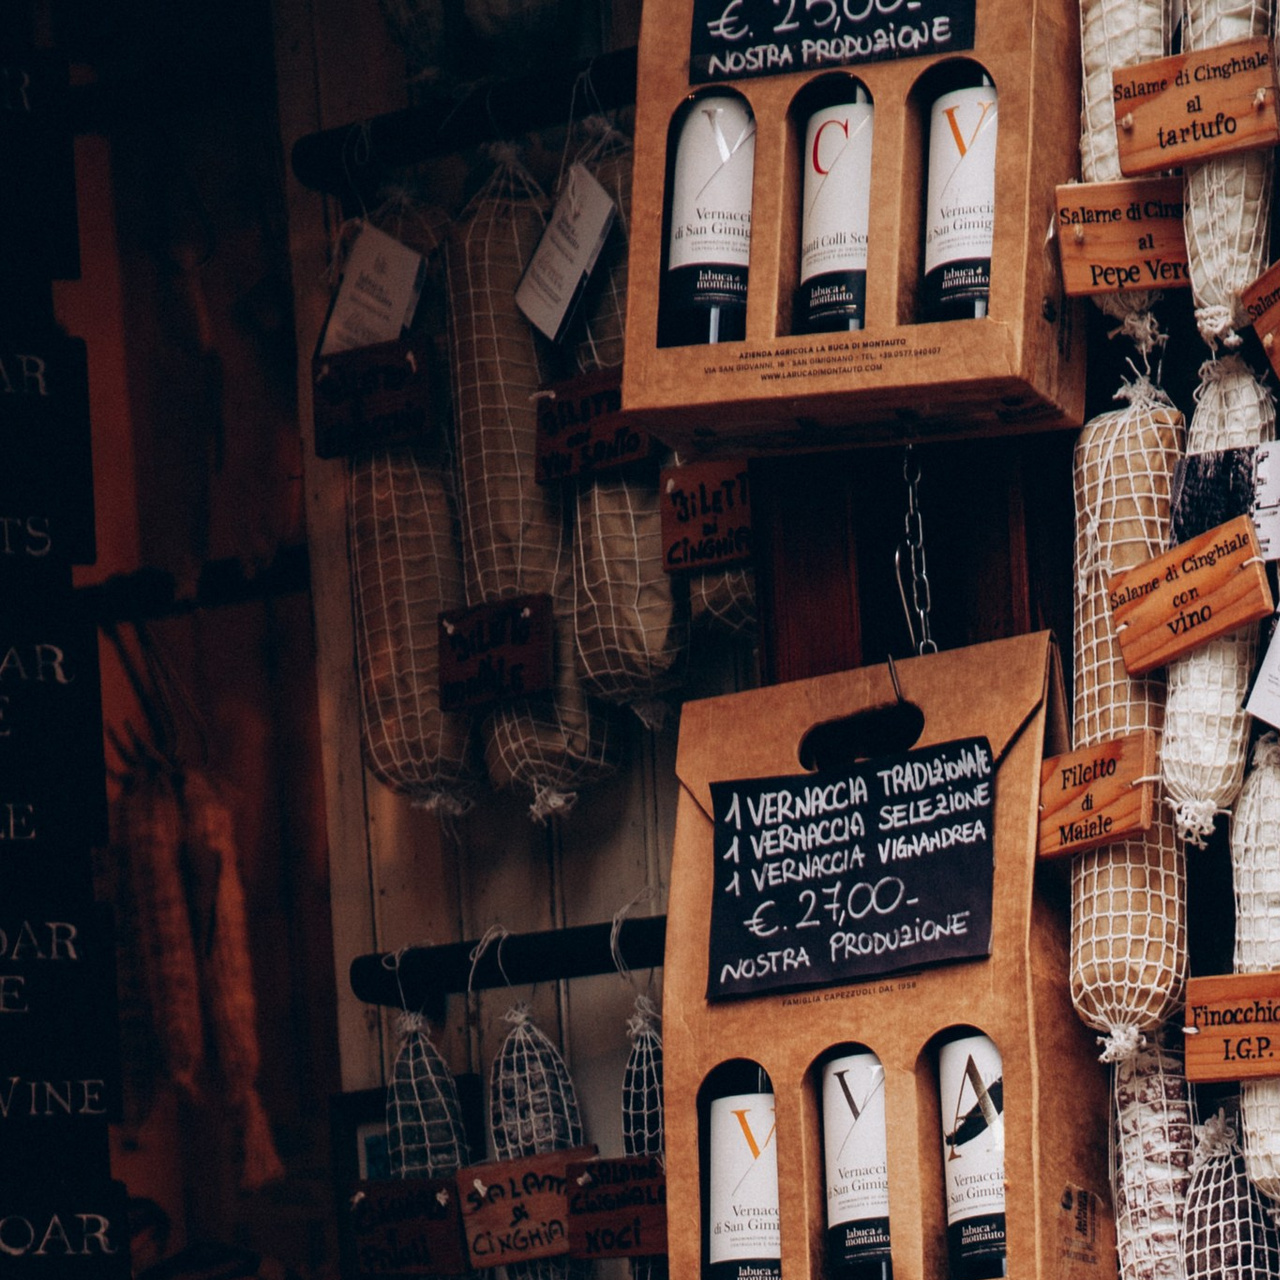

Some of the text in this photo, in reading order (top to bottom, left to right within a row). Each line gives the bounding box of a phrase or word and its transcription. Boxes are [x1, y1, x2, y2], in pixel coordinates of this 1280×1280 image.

[707, 16, 952, 75] NOSTRA PRODUZIONE
[1114, 51, 1270, 101] Salame di Cinghiale
[1186, 95, 1203, 113] al
[1157, 113, 1238, 149] tartufo
[1059, 203, 1141, 226] Salame di
[1138, 234, 1155, 250] al
[697, 279, 747, 292] montauto
[699, 270, 733, 281] labuca
[1090, 263, 1141, 288] Pepe
[739, 347, 772, 360] AZIENDA
[774, 343, 814, 357] AGRICOLA
[816, 342, 827, 354] LA
[828, 341, 850, 353] BUCA
[862, 337, 907, 349] MONTAUTO
[1109, 532, 1250, 611] Salame di Cinghiale
[1172, 586, 1200, 608] con
[1167, 604, 1214, 637] vino
[1061, 754, 1117, 791] Filetto
[747, 776, 869, 828] VERNACCIA
[1081, 792, 1094, 812] di
[749, 782, 992, 861] VERNACCIA SELEZIONE
[1059, 814, 1113, 847] Maiale
[750, 845, 866, 893] VERNACCIA
[720, 910, 971, 984] NOSTRA PRODUZIONE
[1223, 1037, 1275, 1061] I.G.P.
